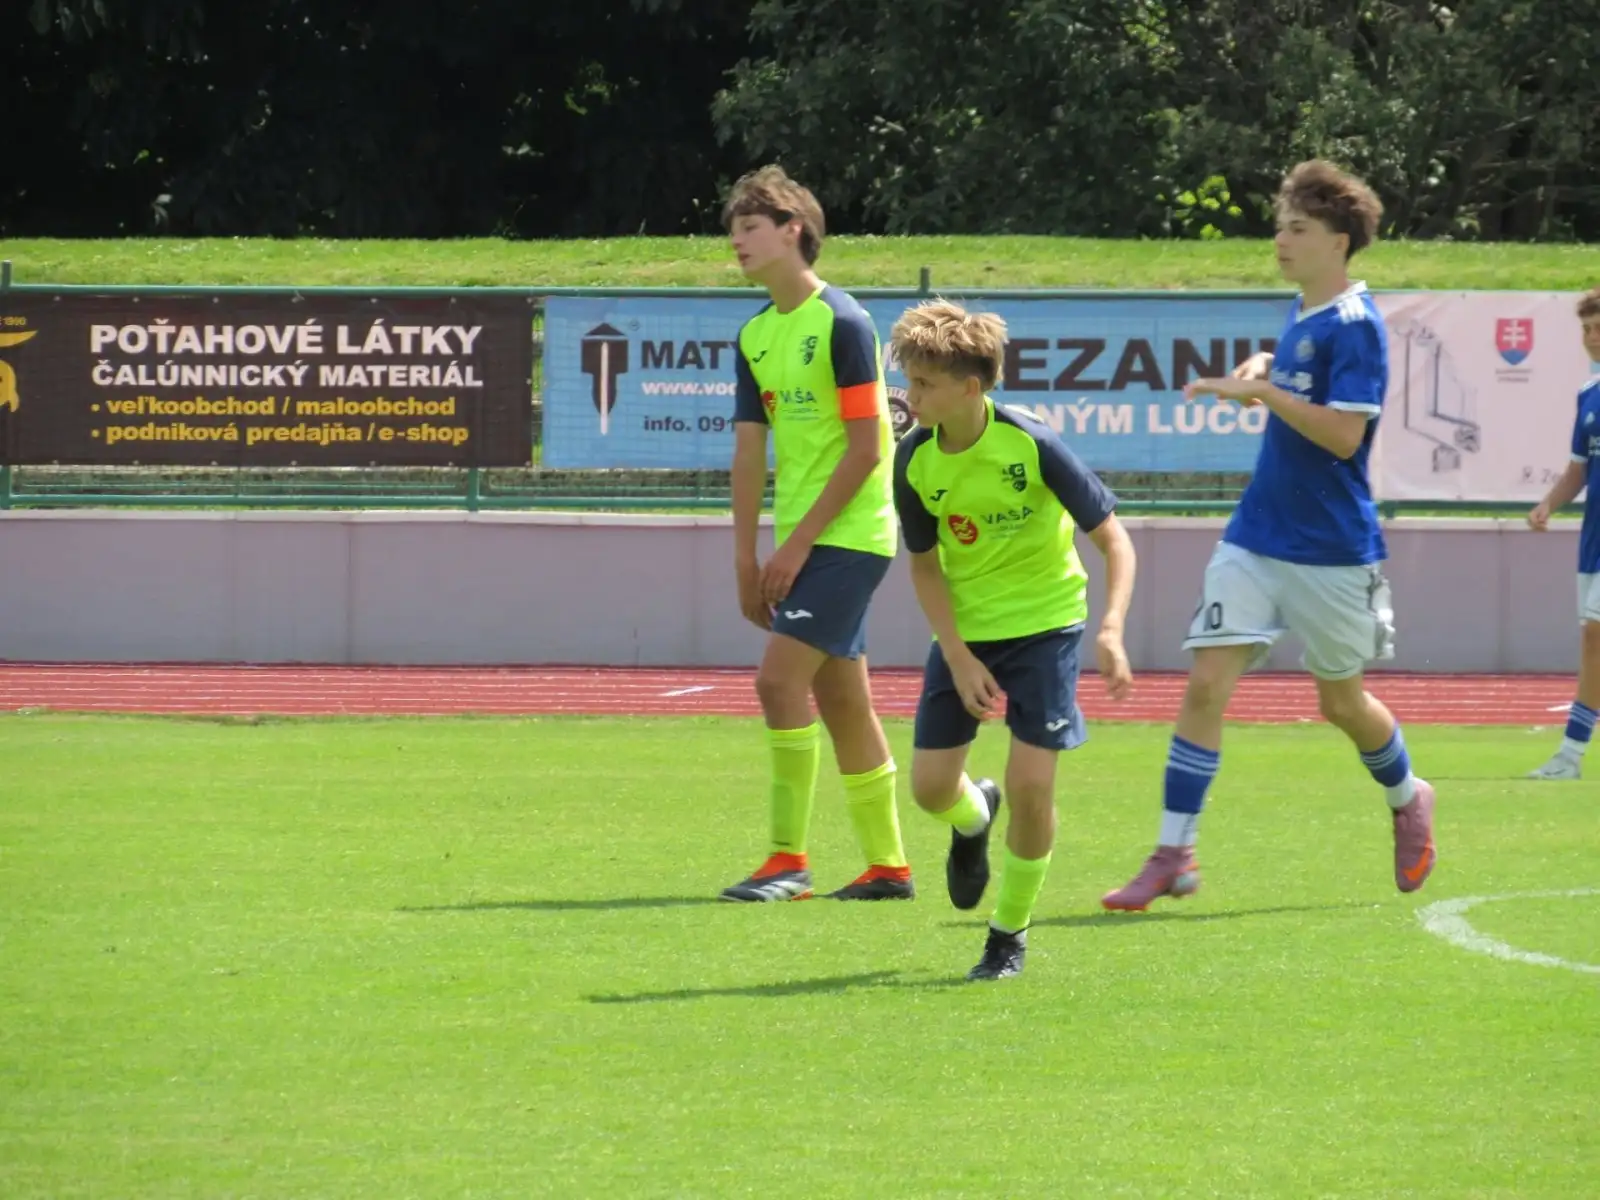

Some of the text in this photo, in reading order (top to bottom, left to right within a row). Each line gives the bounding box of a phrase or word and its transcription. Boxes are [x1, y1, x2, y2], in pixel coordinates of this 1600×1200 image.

[91, 318, 483, 354] POŤAHOVÉ LÁTKY
[641, 340, 737, 370] MAT
[1002, 338, 1277, 391] EZANI
[92, 360, 483, 387] ČALÚNNICKÝ MATERIÁL
[105, 396, 275, 415] veľkoobchod
[296, 396, 456, 415] maloobchod
[1033, 397, 1270, 434] NÝM LÚČO
[106, 422, 238, 444] podniková
[246, 422, 362, 446] predajňa
[378, 423, 470, 446] e-shop
[644, 416, 692, 432] info.
